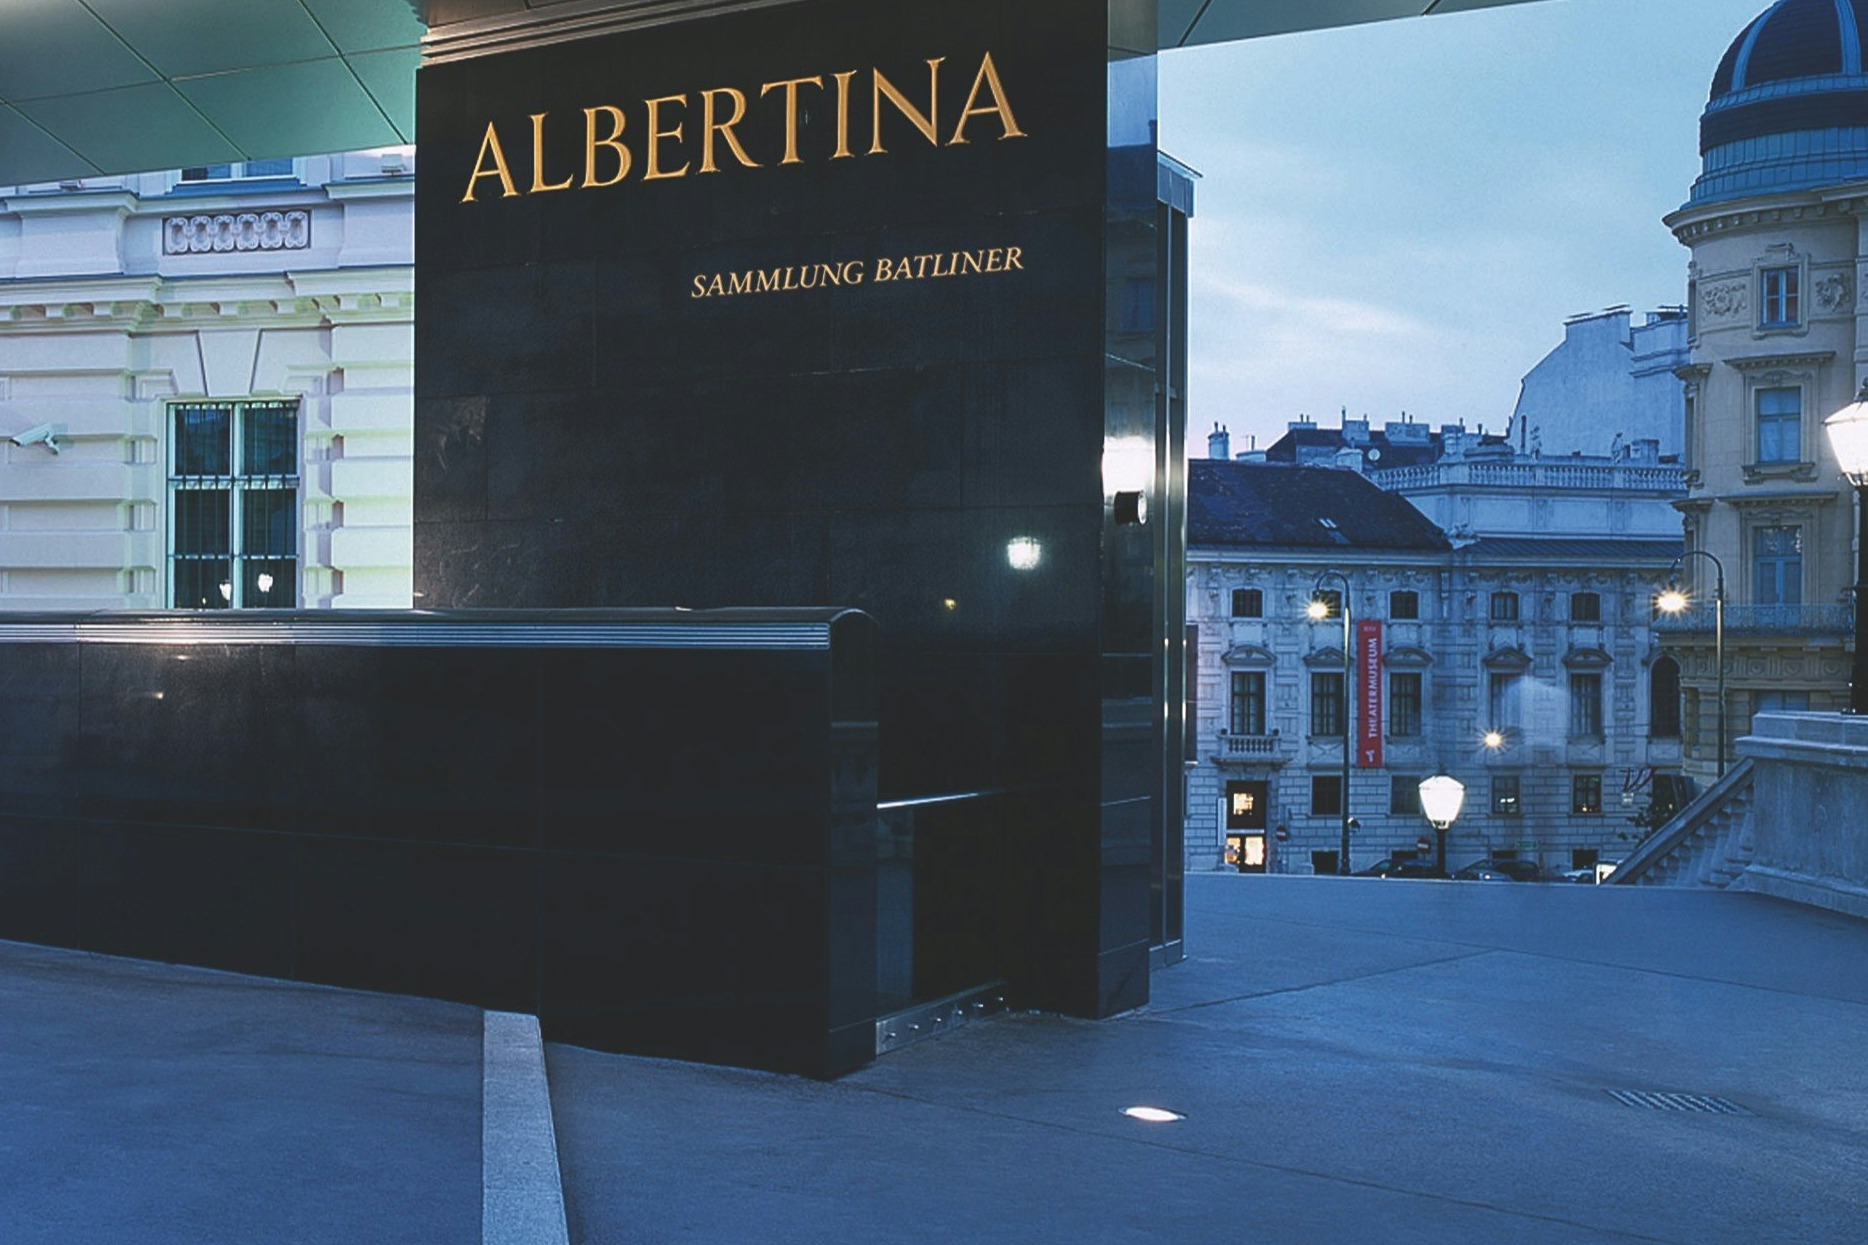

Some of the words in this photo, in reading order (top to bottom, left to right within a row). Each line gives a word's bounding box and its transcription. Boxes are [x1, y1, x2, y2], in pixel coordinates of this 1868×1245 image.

[459, 51, 1028, 204] ALBERTINA
[691, 260, 865, 299] SAMMLUNG
[874, 246, 1024, 283] BATLINER
[1368, 637, 1378, 738] THEATERMUSEUM
